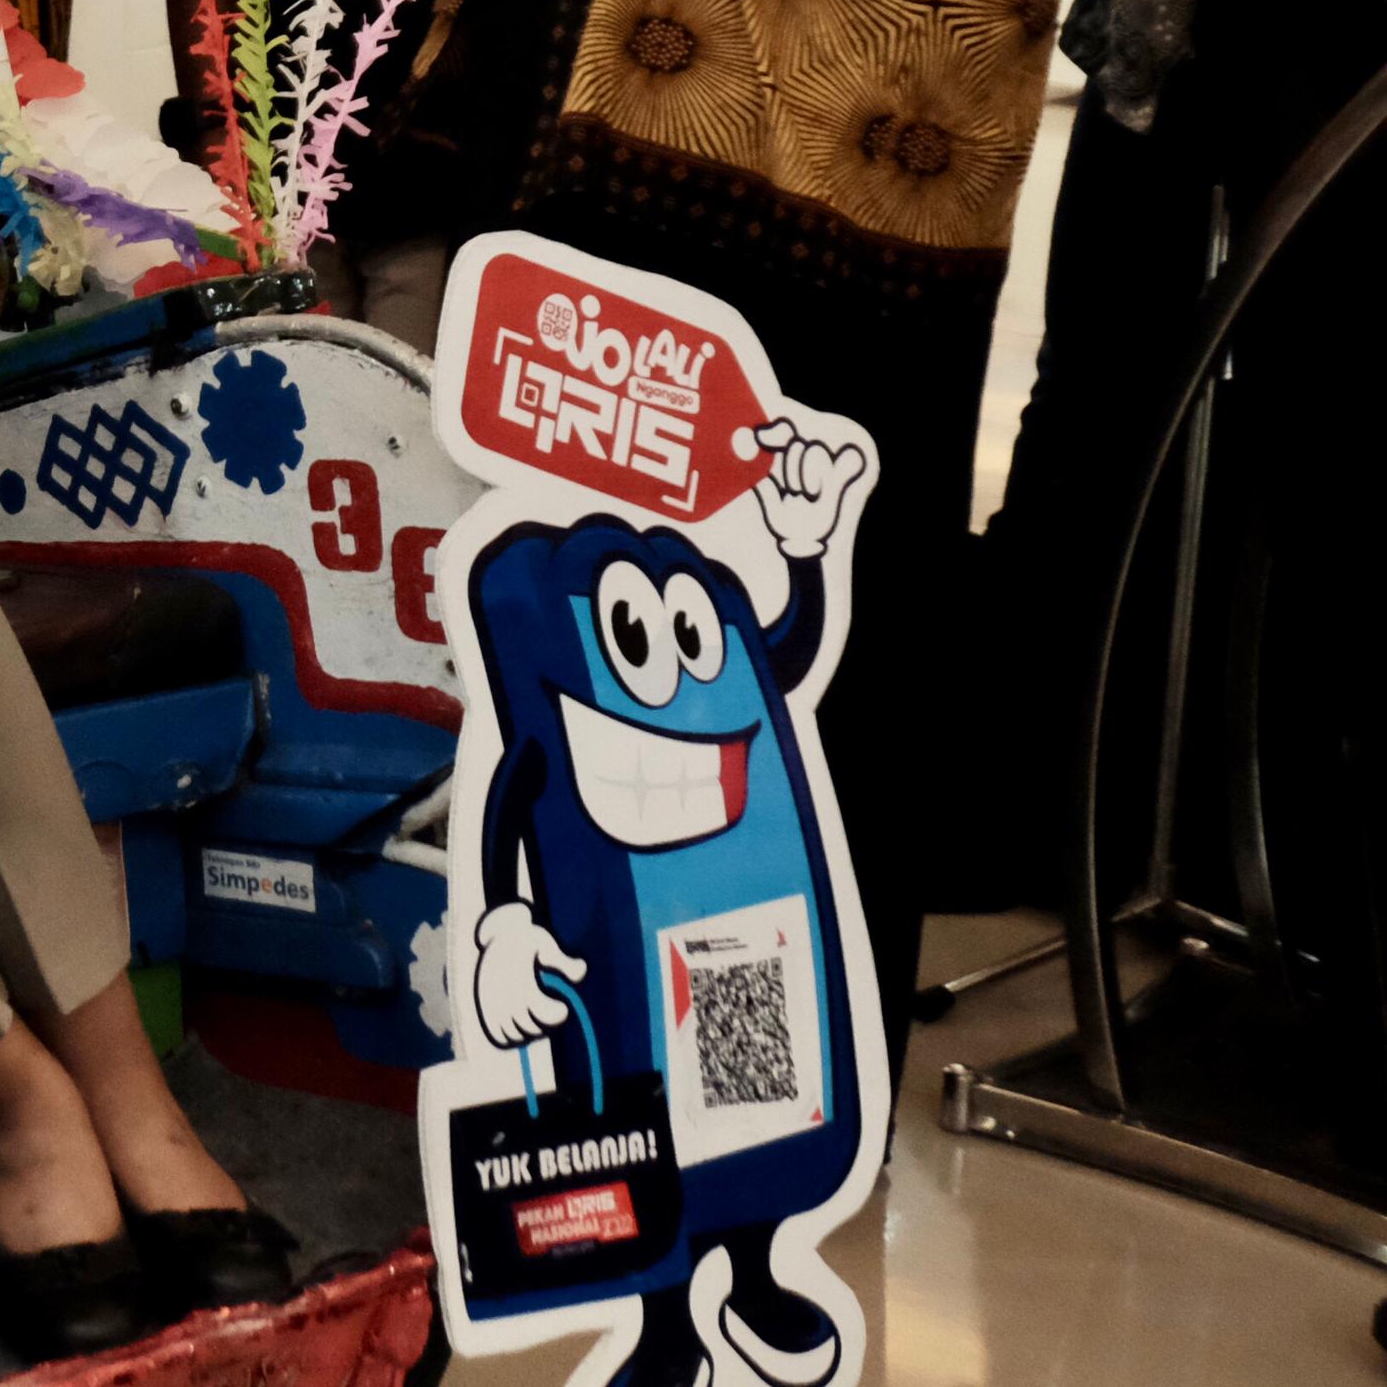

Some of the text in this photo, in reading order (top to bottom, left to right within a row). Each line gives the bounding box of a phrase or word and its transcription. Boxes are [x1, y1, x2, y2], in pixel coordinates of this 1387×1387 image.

[636, 380, 694, 407] Nganggo
[498, 353, 695, 489] QRIS
[207, 865, 310, 900] Simpedes
[475, 1128, 659, 1192] YUK BELANJA!
